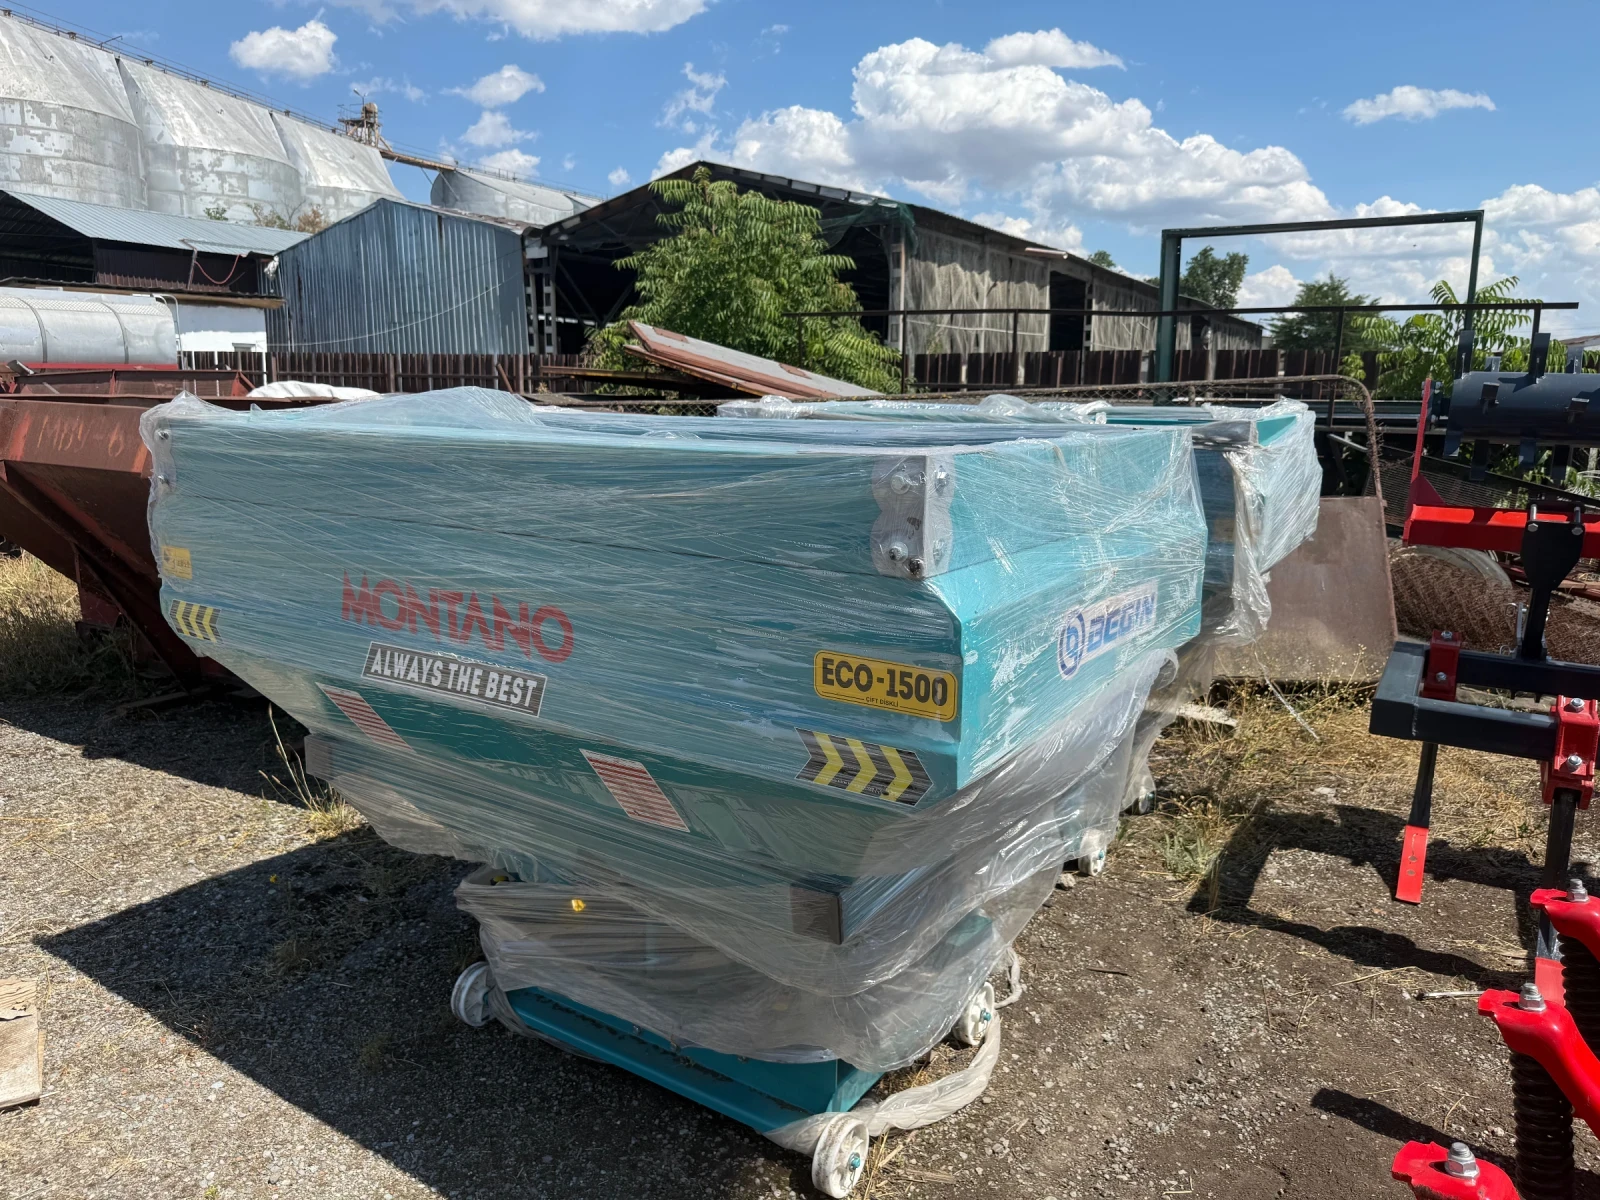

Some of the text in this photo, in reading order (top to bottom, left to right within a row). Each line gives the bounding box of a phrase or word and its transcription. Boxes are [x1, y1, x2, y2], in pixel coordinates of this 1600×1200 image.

[341, 570, 574, 663] MONTANO
[1086, 591, 1156, 653] BEGIN
[371, 648, 538, 707] ALWAYS THE BEST
[821, 657, 948, 707] ECO-1500
